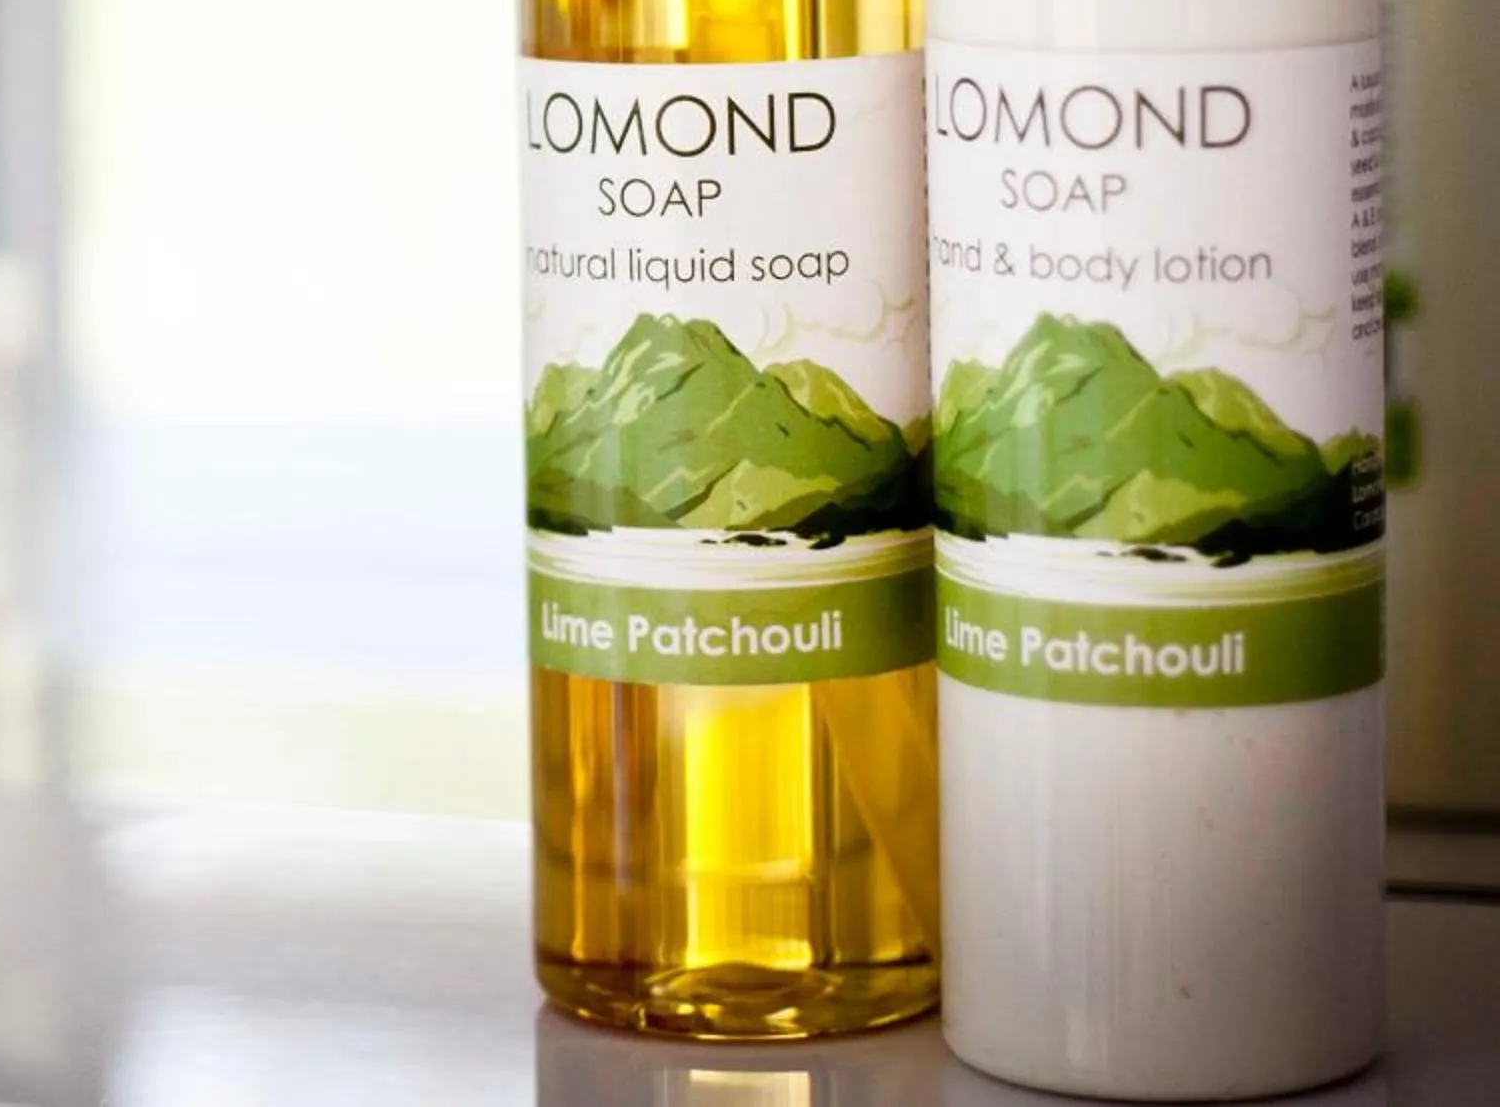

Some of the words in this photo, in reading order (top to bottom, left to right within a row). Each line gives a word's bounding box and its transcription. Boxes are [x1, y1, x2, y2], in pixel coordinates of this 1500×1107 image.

[527, 90, 837, 157] LOMOND
[934, 75, 1251, 150] LOMOND
[597, 178, 722, 217] SOAP
[1000, 168, 1128, 213] SOAP
[526, 243, 616, 280] natural
[628, 248, 735, 289] liquid
[751, 250, 849, 284] soap
[994, 242, 1015, 277] &
[1029, 246, 1138, 290] body
[1154, 246, 1272, 284] lotion
[542, 601, 614, 650] Lime
[627, 610, 842, 656] Patchouli
[945, 605, 1007, 661] Lime
[1021, 616, 1245, 676] Patchouli
